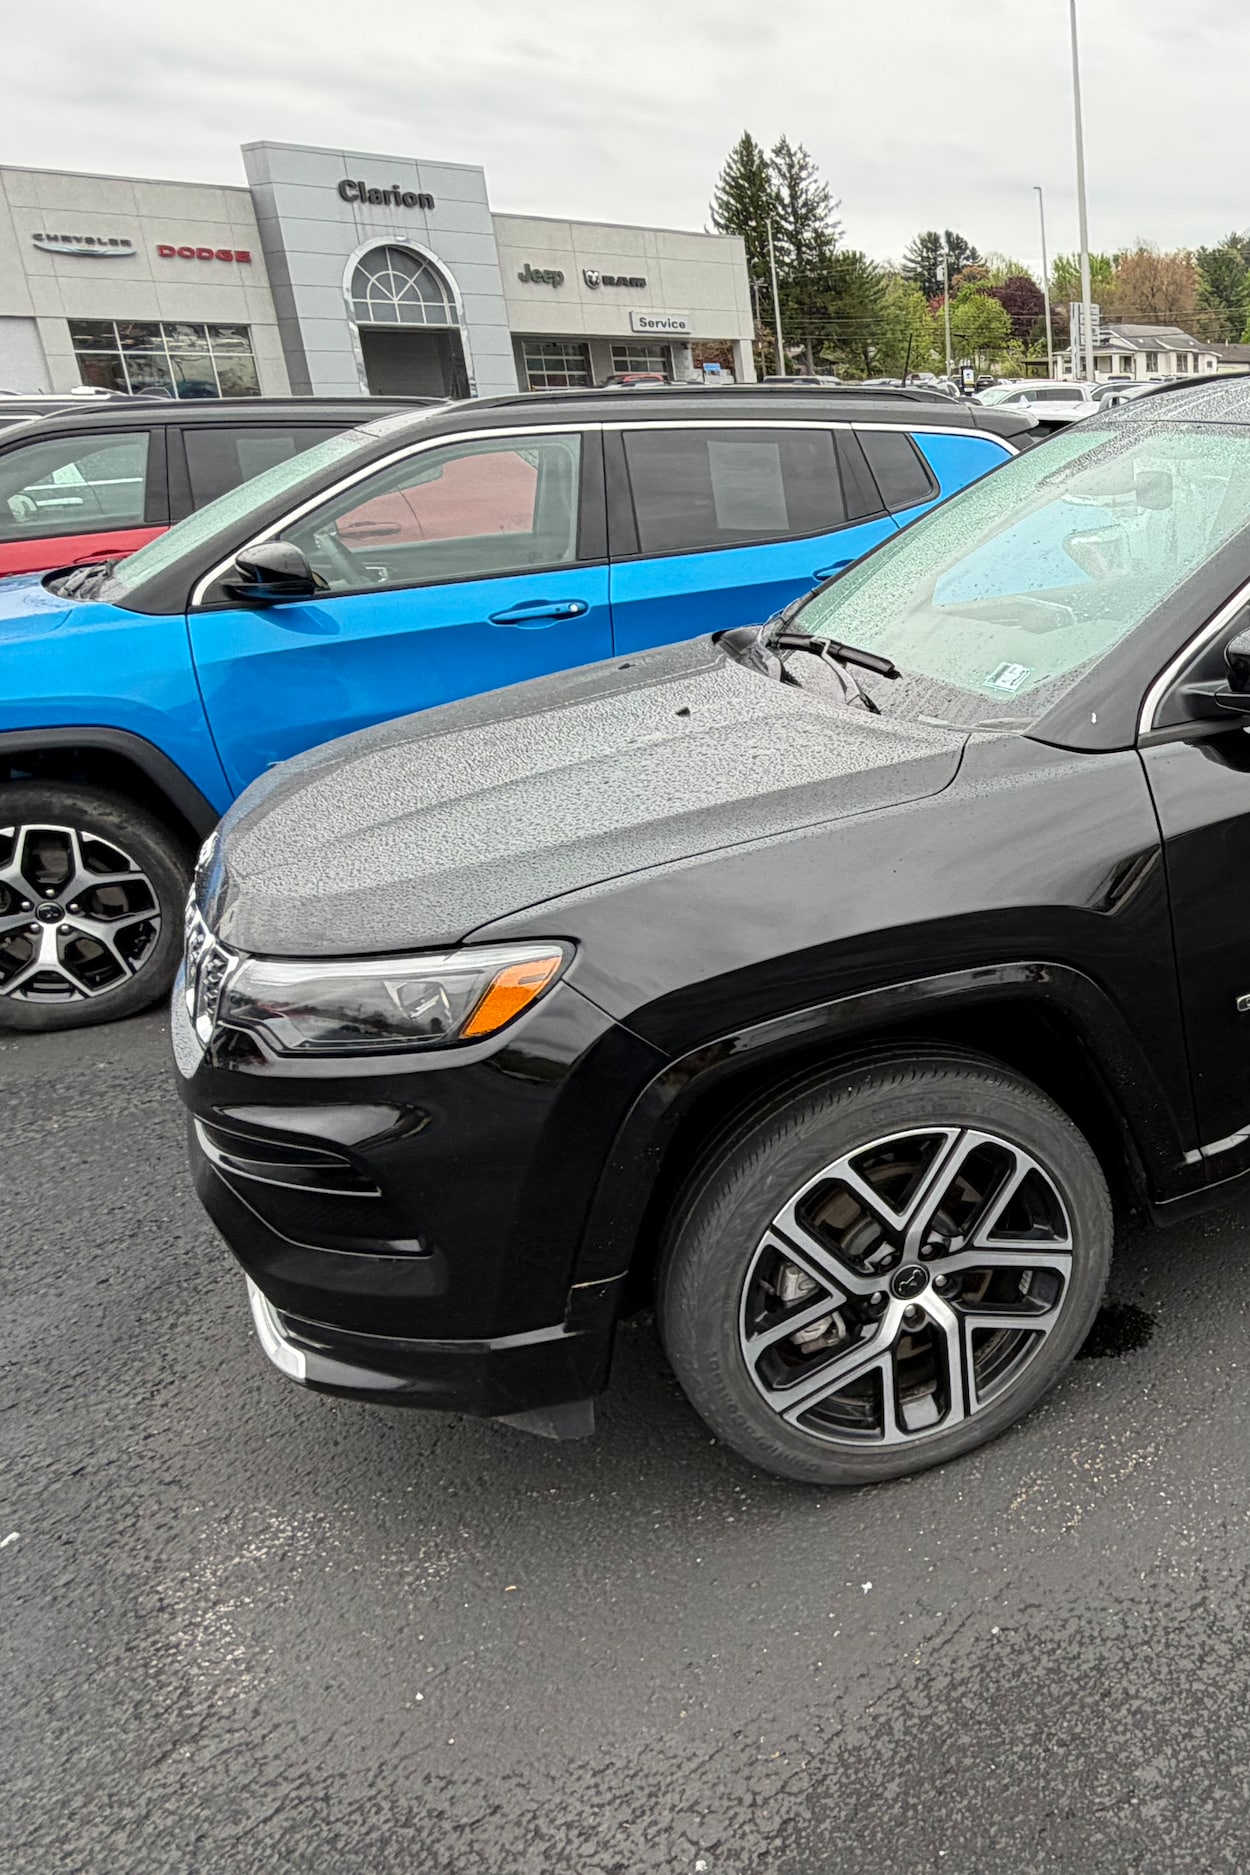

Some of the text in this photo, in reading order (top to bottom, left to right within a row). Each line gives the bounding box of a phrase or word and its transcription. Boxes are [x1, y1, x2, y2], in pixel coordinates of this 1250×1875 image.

[338, 179, 435, 210] Clarion
[32, 233, 132, 247] CHRYSLER
[157, 244, 251, 263] DODGE
[517, 263, 564, 288] Jeep
[602, 275, 647, 288] RAM
[639, 316, 686, 329] Service
